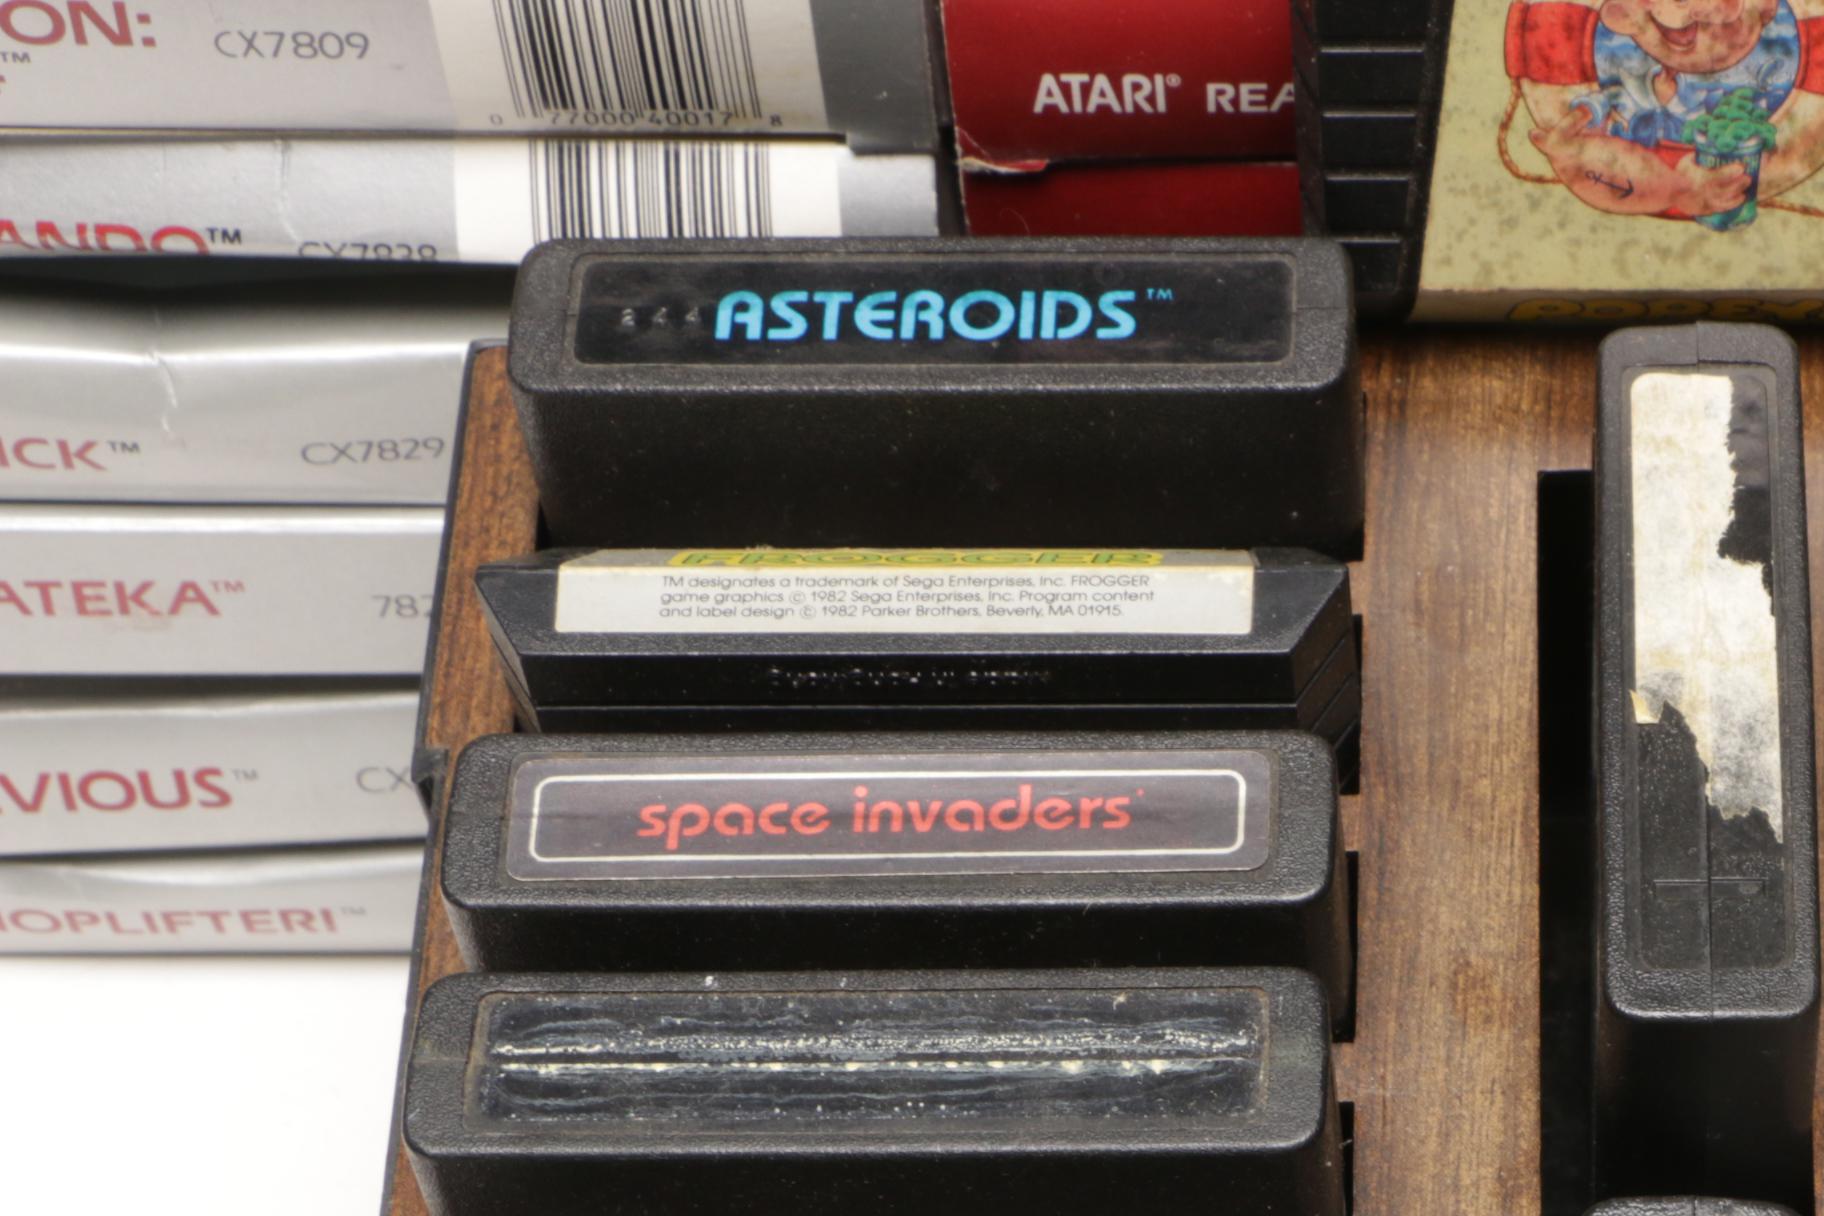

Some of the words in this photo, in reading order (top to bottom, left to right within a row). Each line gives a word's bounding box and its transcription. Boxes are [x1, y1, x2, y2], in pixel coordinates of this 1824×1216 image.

[214, 31, 370, 59] CX7809
[300, 437, 445, 466] CX7829
[668, 549, 1163, 567] FROGGER
[662, 575, 684, 588] TM
[688, 575, 775, 590] designates
[780, 578, 791, 588] a
[796, 575, 878, 588] trademark
[883, 575, 898, 588] of
[903, 575, 944, 590] Sega
[1071, 574, 1150, 588] FROGGER
[661, 591, 709, 605] game
[714, 590, 784, 605] graphics
[812, 590, 847, 603] 1982
[851, 590, 892, 605] Sega
[1019, 590, 1088, 605] Program
[1092, 590, 1154, 602] content
[659, 606, 692, 618] and
[696, 606, 736, 618] label
[741, 606, 794, 620] design
[822, 605, 857, 617] 1982
[862, 605, 910, 617] Parker
[1049, 605, 1072, 617] MA
[636, 801, 833, 852] space
